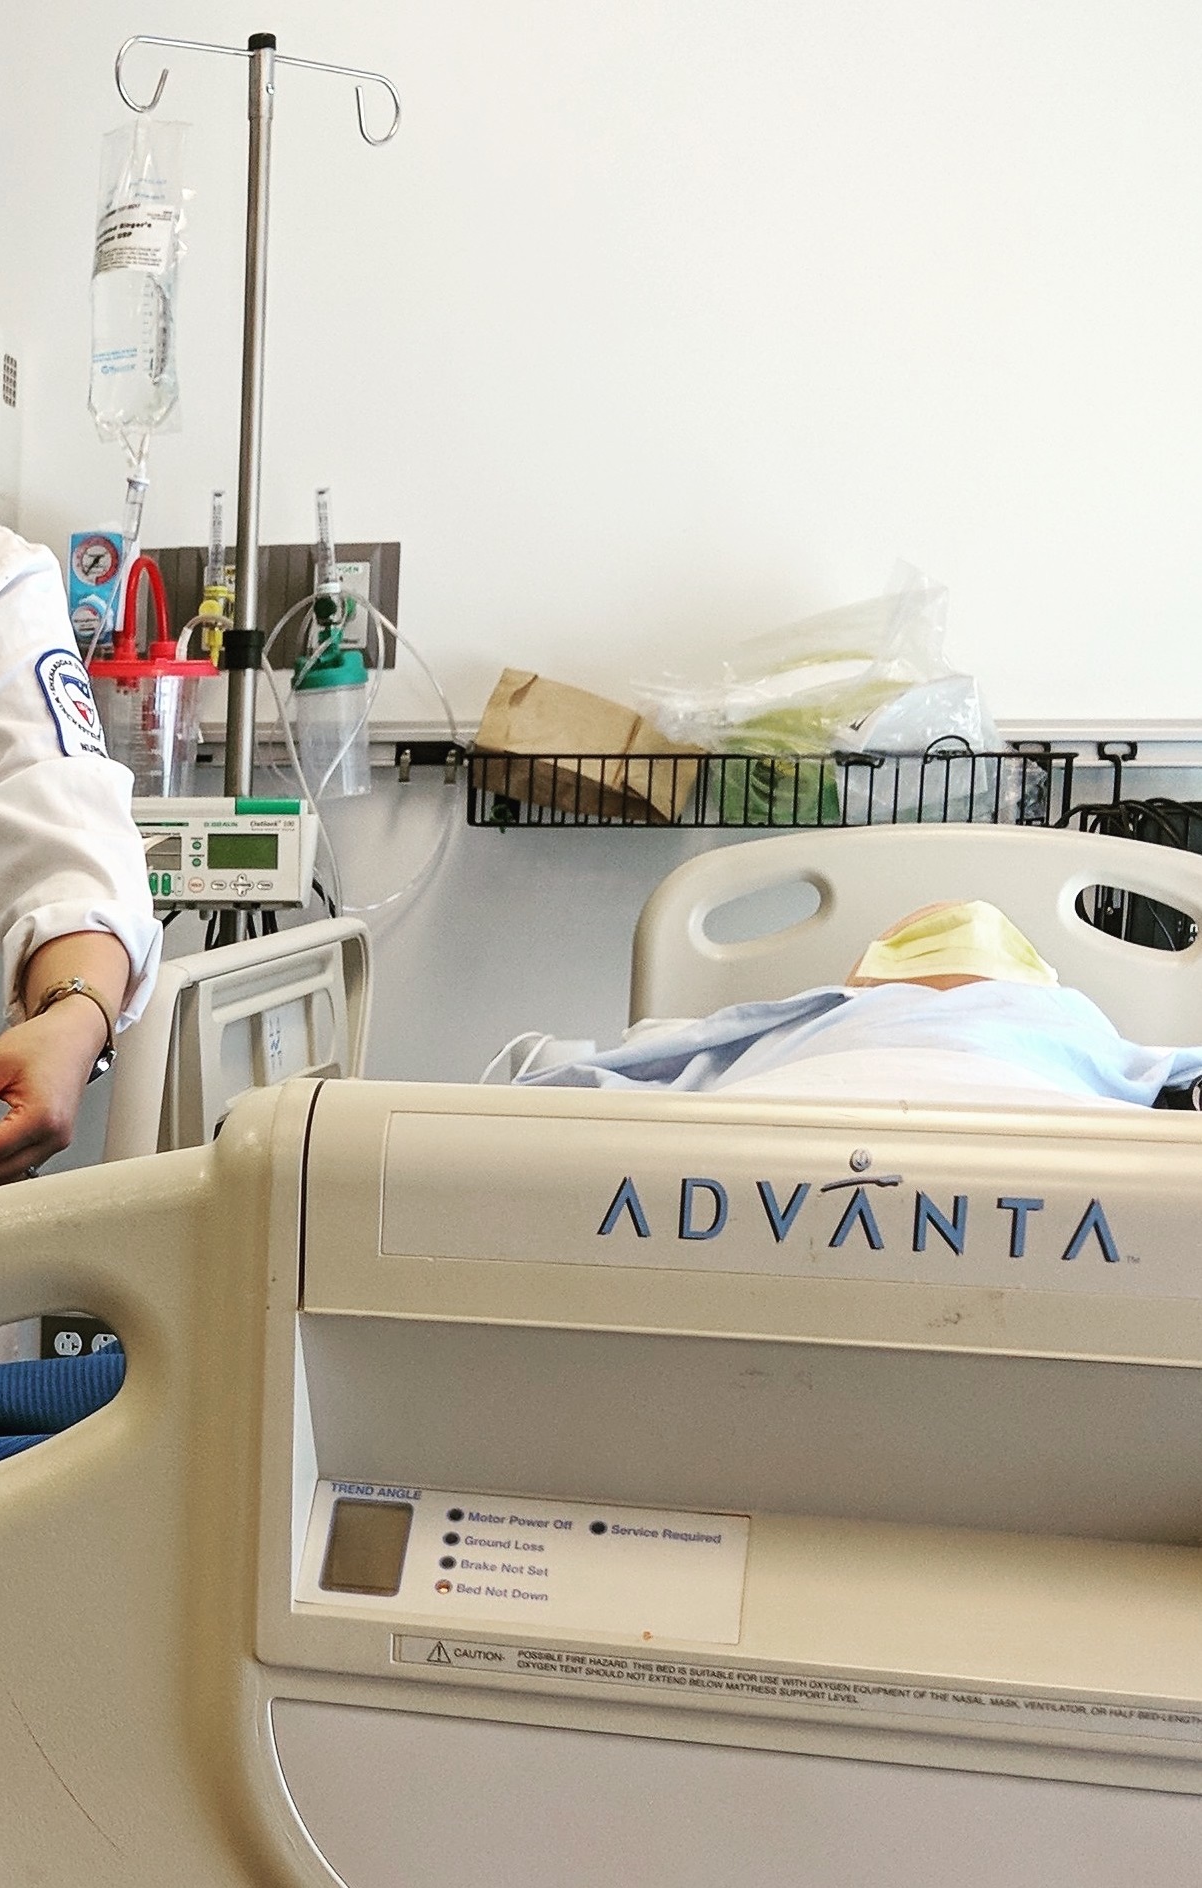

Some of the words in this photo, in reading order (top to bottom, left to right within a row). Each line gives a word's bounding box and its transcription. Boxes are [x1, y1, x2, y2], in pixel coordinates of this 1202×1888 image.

[596, 1173, 1121, 1265] ADVANTA
[332, 1483, 374, 1497] TREND
[377, 1487, 423, 1500] ANGLE
[467, 1511, 506, 1525] Motor
[509, 1515, 549, 1529] Power
[553, 1519, 573, 1531] Off
[464, 1535, 511, 1550] Ground
[514, 1540, 546, 1552] Loss
[610, 1524, 659, 1539] Service
[662, 1529, 723, 1544] Required
[460, 1559, 498, 1573] Brake
[501, 1563, 525, 1575] Not
[527, 1566, 549, 1577] Set
[456, 1583, 482, 1596] Bed
[485, 1586, 509, 1598] Not
[511, 1589, 549, 1602] Down
[516, 1660, 558, 1672] OXYGEN
[559, 1664, 583, 1674] TENT
[584, 1667, 625, 1679] SHOULD
[626, 1671, 646, 1681] NOT
[648, 1674, 687, 1686] EXTEND
[688, 1678, 723, 1690] BELOW
[724, 1682, 778, 1696] MATTRESS
[779, 1687, 826, 1699] SUPPORT
[517, 1650, 563, 1662] POSSIBLE
[565, 1654, 587, 1664] FIRE
[632, 1661, 653, 1672] THIS
[655, 1664, 676, 1674] BED
[677, 1666, 687, 1676] IS
[689, 1667, 734, 1680] SUITABLE
[736, 1672, 757, 1682] FOR
[759, 1674, 779, 1686] USE
[781, 1678, 808, 1688] WITH
[809, 1680, 851, 1692] OXYGEN
[852, 1684, 911, 1698] EQUIPMENT
[912, 1689, 927, 1699] OF
[929, 1691, 948, 1702] THE
[1091, 1706, 1107, 1716] OR
